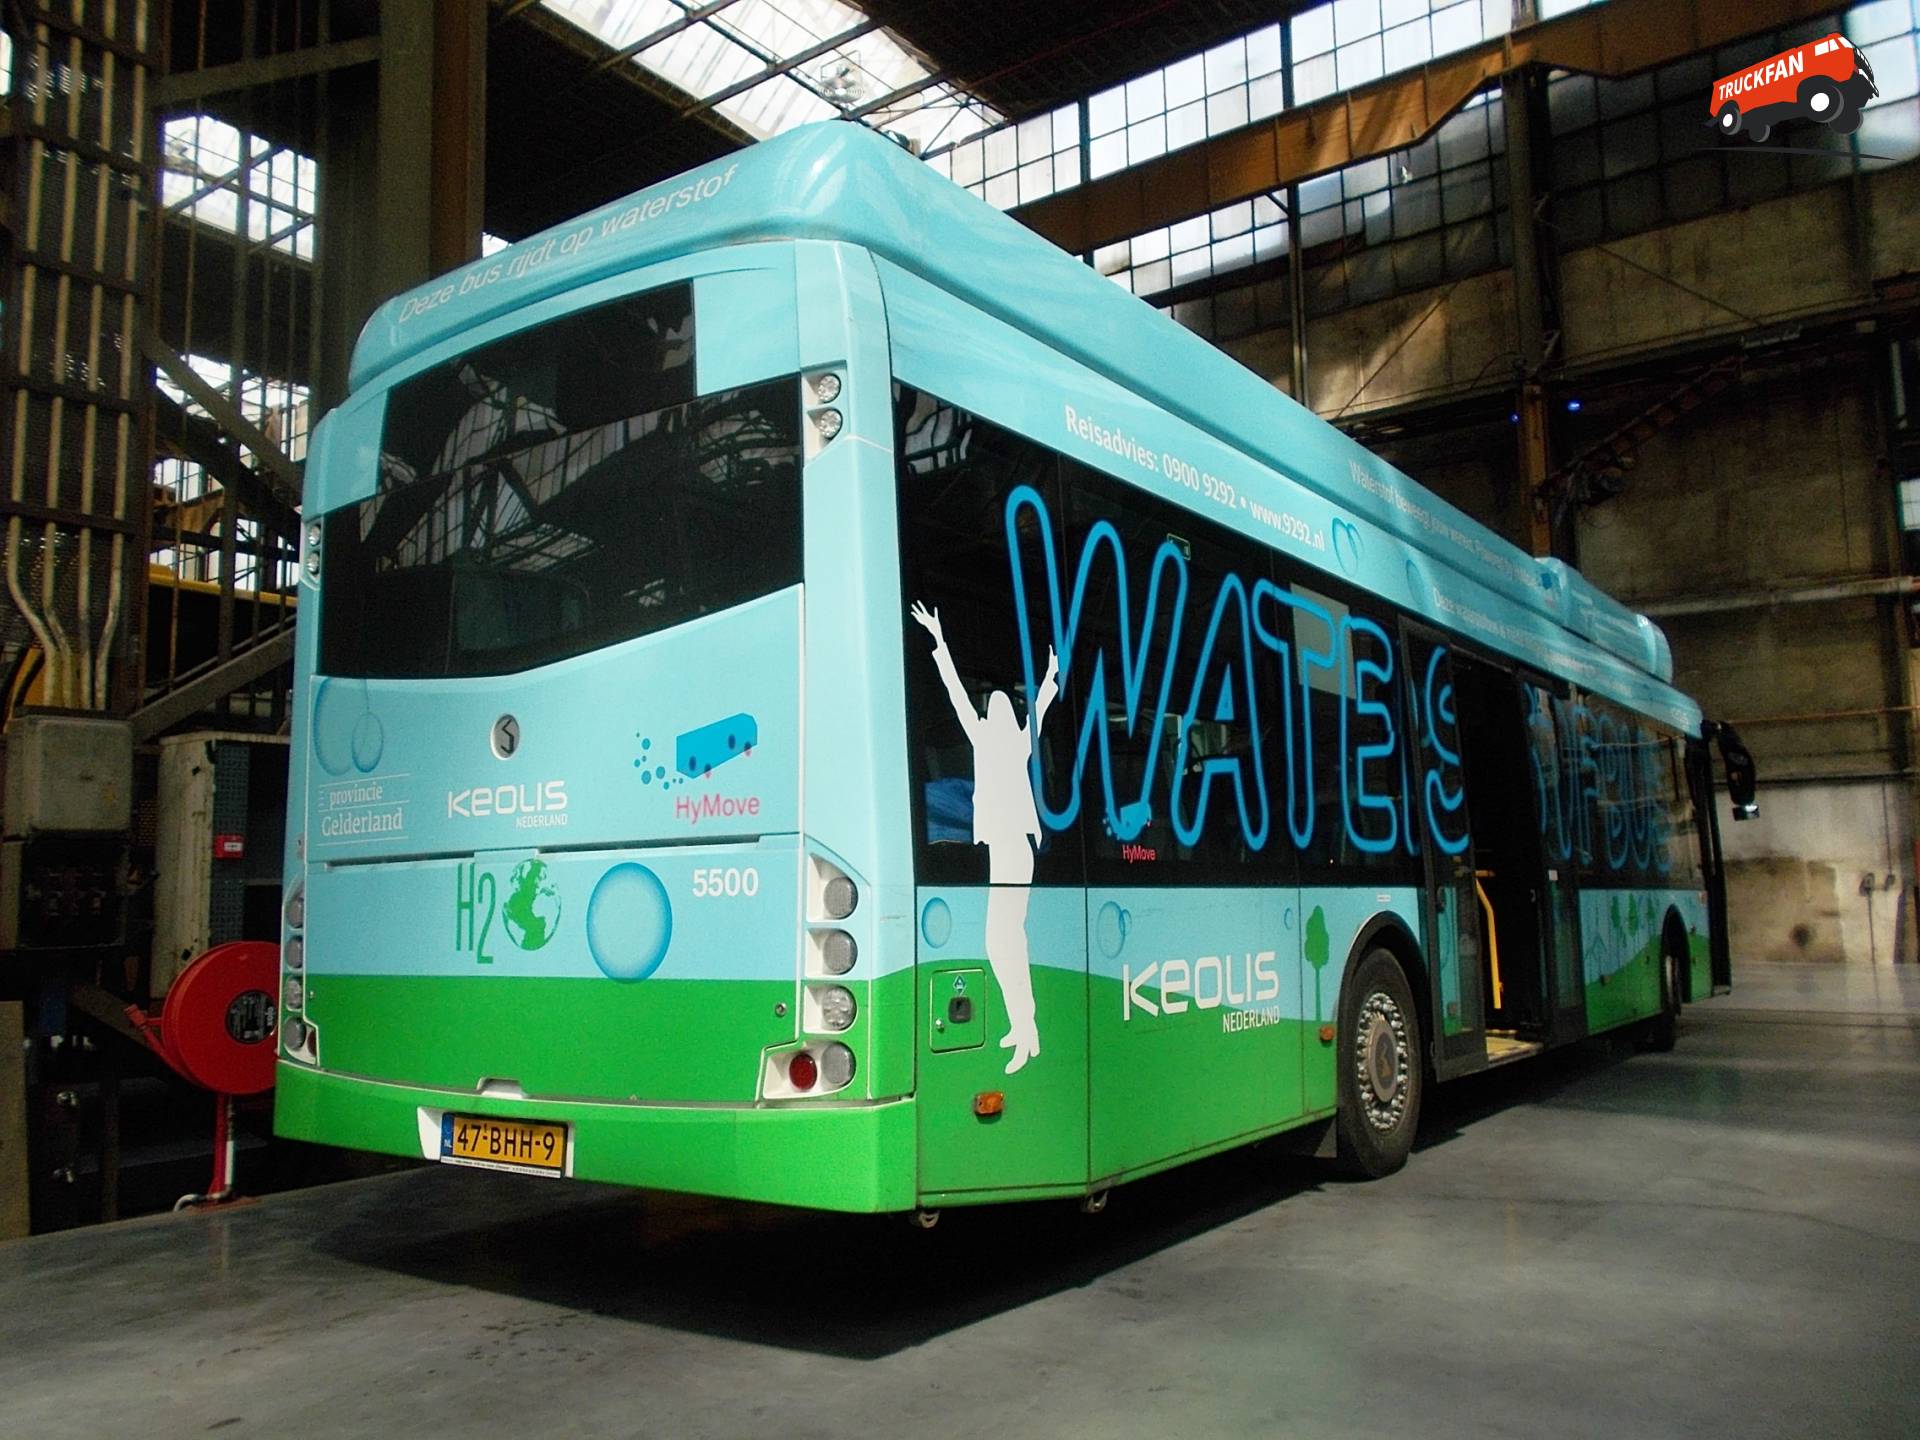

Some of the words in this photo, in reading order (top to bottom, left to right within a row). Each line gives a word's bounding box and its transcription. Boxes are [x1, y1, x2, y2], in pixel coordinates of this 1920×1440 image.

[400, 282, 455, 322] Deze
[459, 260, 501, 296] bus
[506, 238, 551, 281] rijdt
[560, 225, 592, 256] op
[600, 163, 738, 239] waterstof
[1064, 404, 1160, 472] Reisadvies:
[1162, 453, 1200, 492] 0900
[1202, 475, 1238, 510] 9292
[1249, 498, 1326, 552] www.9292.nl
[329, 782, 383, 806] provincie
[322, 808, 403, 836] Gelderland
[516, 814, 568, 829] NEDERLAND
[676, 794, 760, 824] HyMove
[1122, 844, 1156, 864] HyMove
[692, 868, 759, 897] 5500
[1223, 1005, 1280, 1033] NEDERLAND
[457, 1123, 556, 1161] 47-BHH-9
